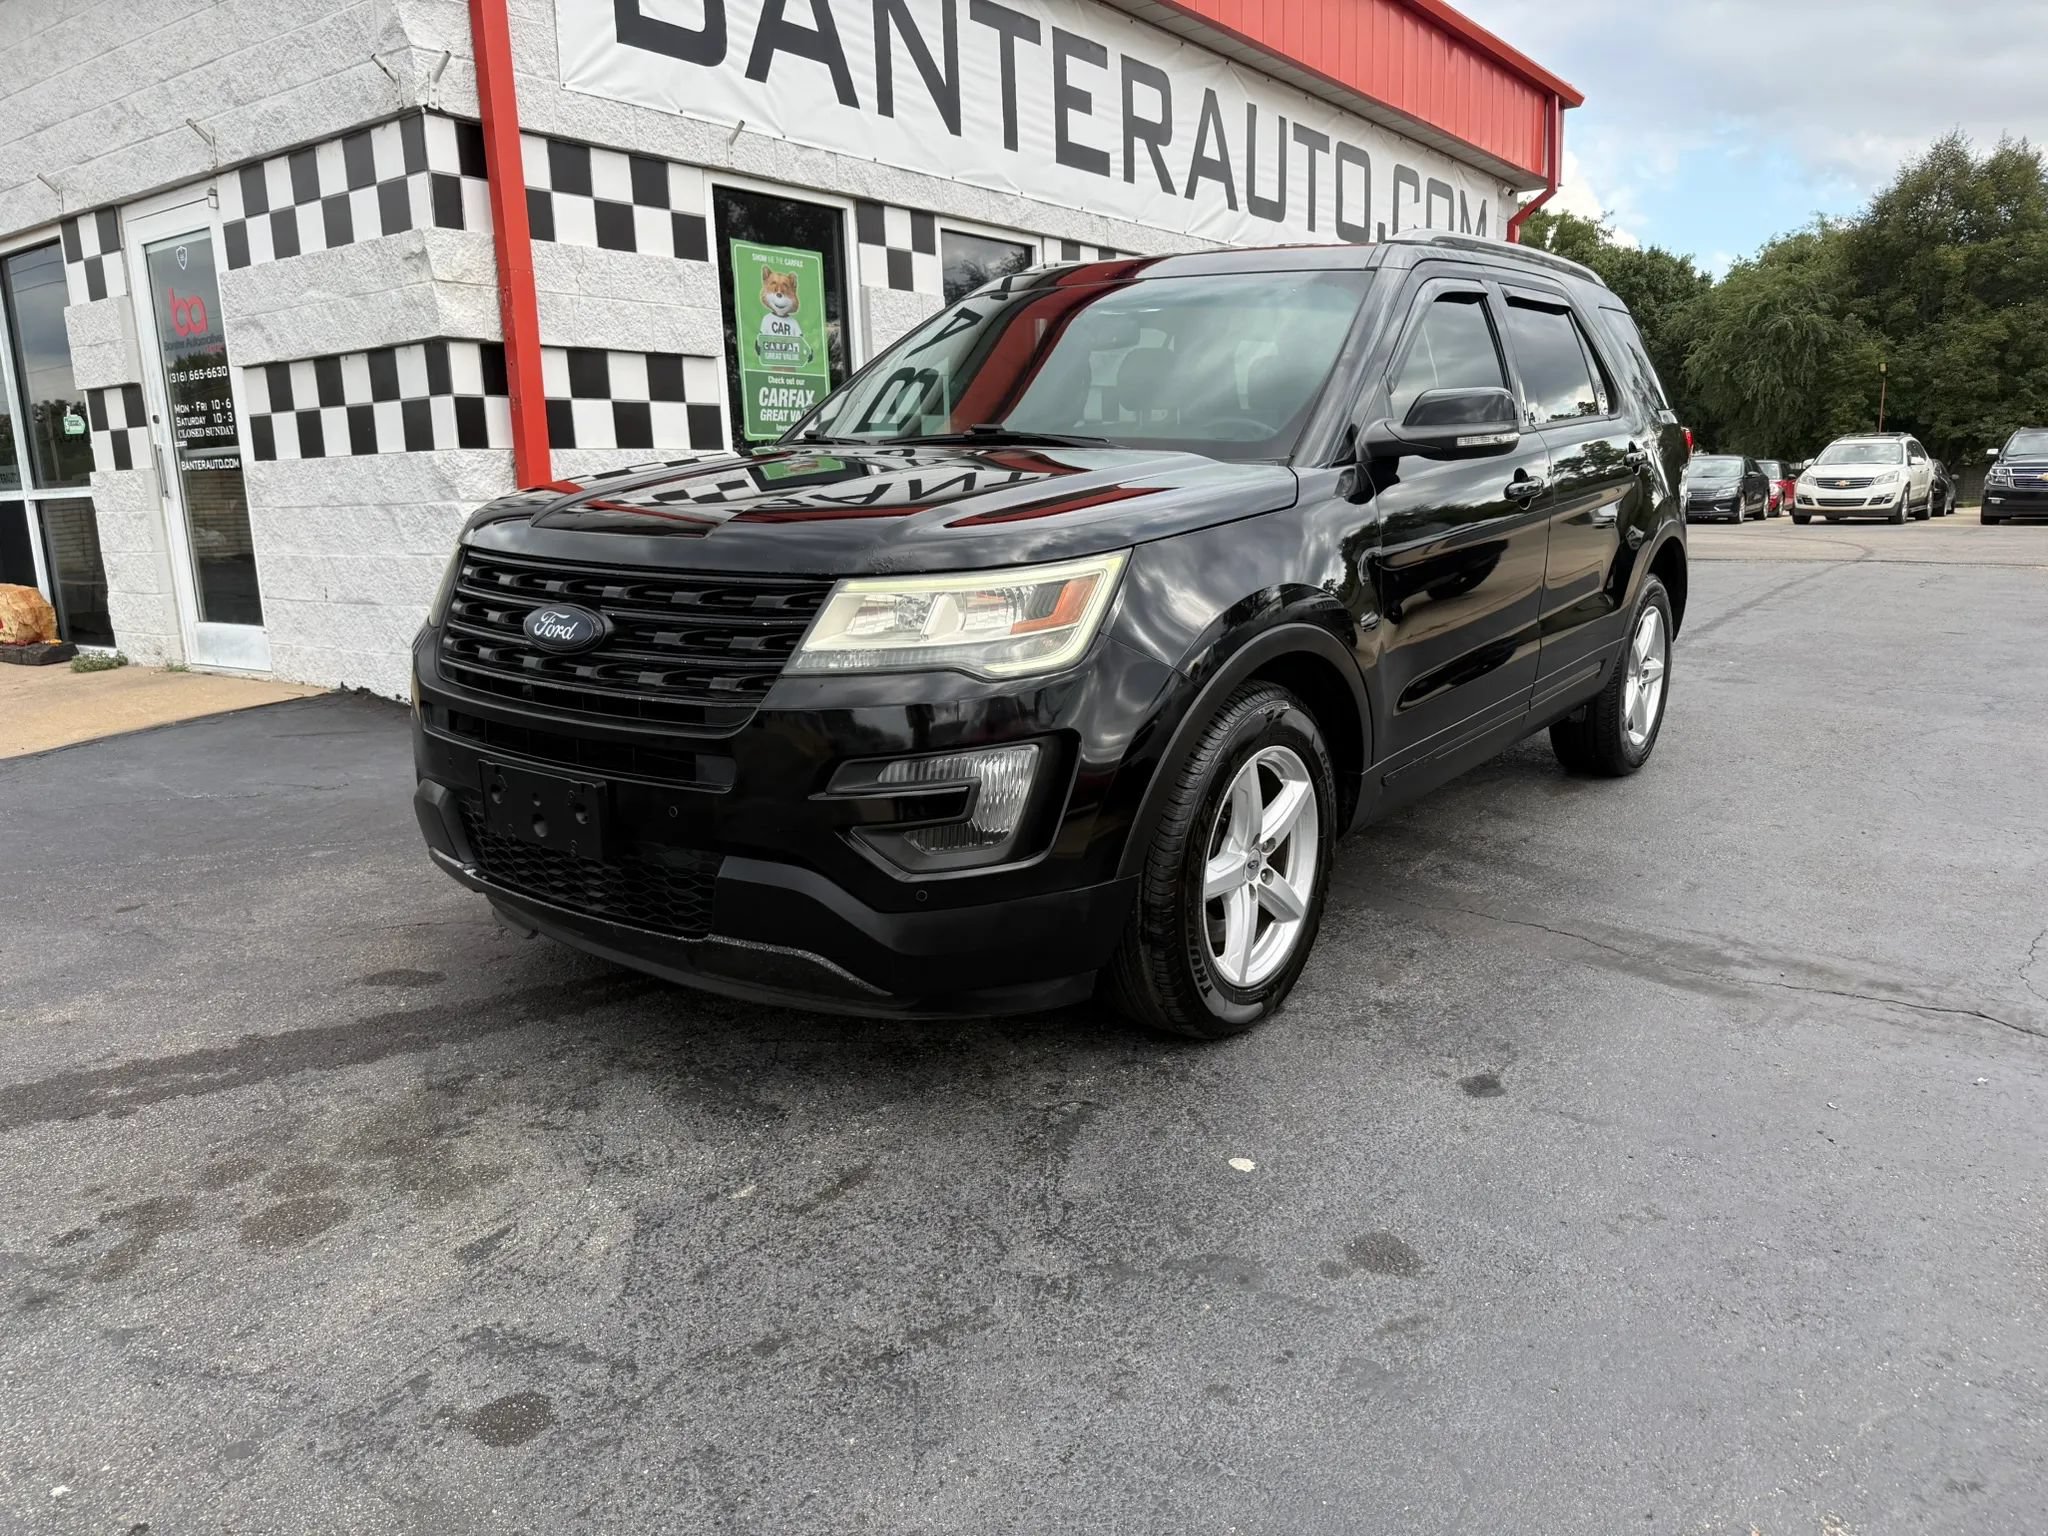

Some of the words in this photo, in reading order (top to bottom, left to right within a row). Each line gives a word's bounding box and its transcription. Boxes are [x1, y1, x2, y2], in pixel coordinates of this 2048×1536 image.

[613, 0, 1487, 242] ANTERAUTO.COM
[771, 321, 791, 336] CAR
[169, 371, 188, 384] (316)
[189, 365, 229, 381] 665-6630
[767, 375, 785, 384] Check
[786, 377, 795, 385] out
[211, 399, 221, 410] 10
[226, 398, 232, 408] 6
[758, 386, 816, 408] CARFAX
[213, 412, 223, 423] 10
[227, 412, 234, 422] 3
[760, 408, 789, 422] GREAT
[177, 428, 205, 439] CLOSED
[205, 425, 235, 437] SUNDAY
[181, 457, 241, 471] BANTERAUTO.COM
[534, 610, 580, 639] Ford
